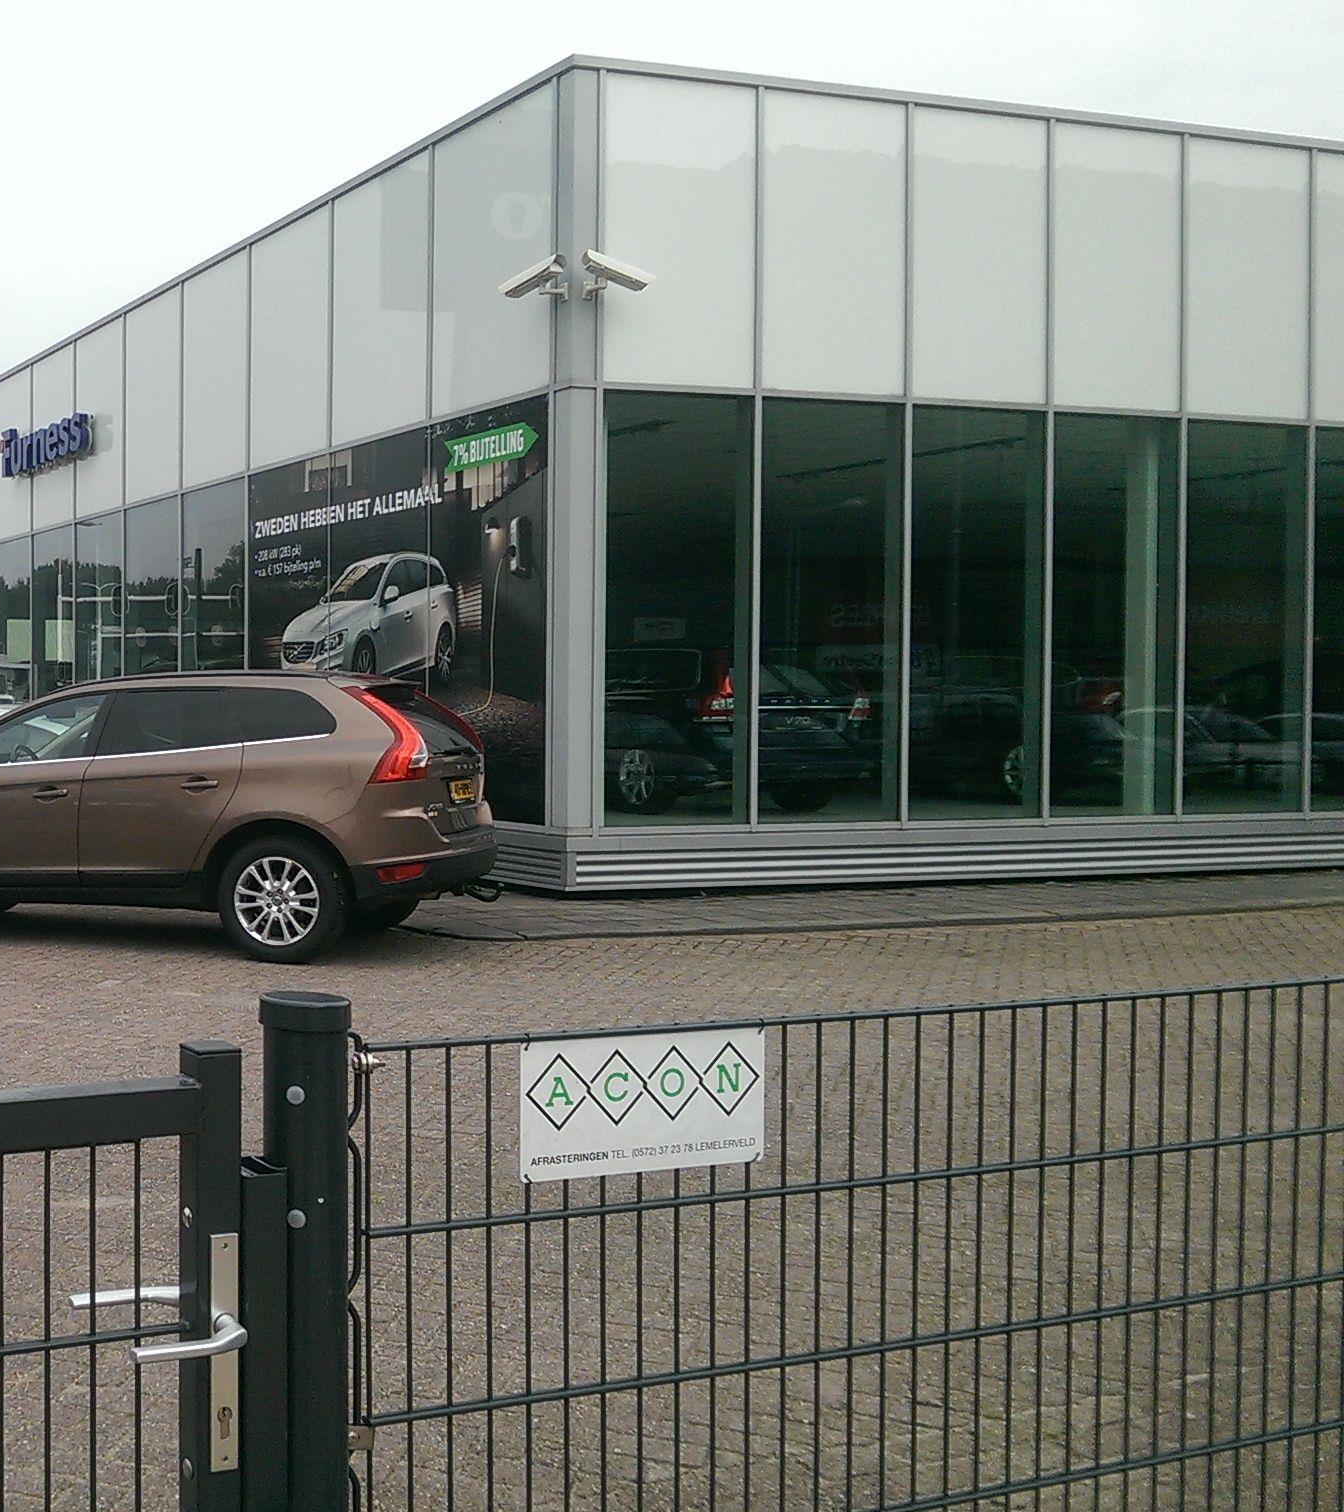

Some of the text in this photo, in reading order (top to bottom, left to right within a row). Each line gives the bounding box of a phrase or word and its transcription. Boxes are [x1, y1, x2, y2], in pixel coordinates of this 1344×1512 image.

[0, 412, 93, 478] Furness
[453, 429, 524, 466] 7% BIJTELLING
[255, 484, 442, 538] ZWEDEN HEBBEN HET ALLEMAAL
[544, 1062, 742, 1108] ACON
[530, 1137, 756, 1167] AFRASTERINGEN TEL. (0572) 37 23 78 LEMELERVELD
